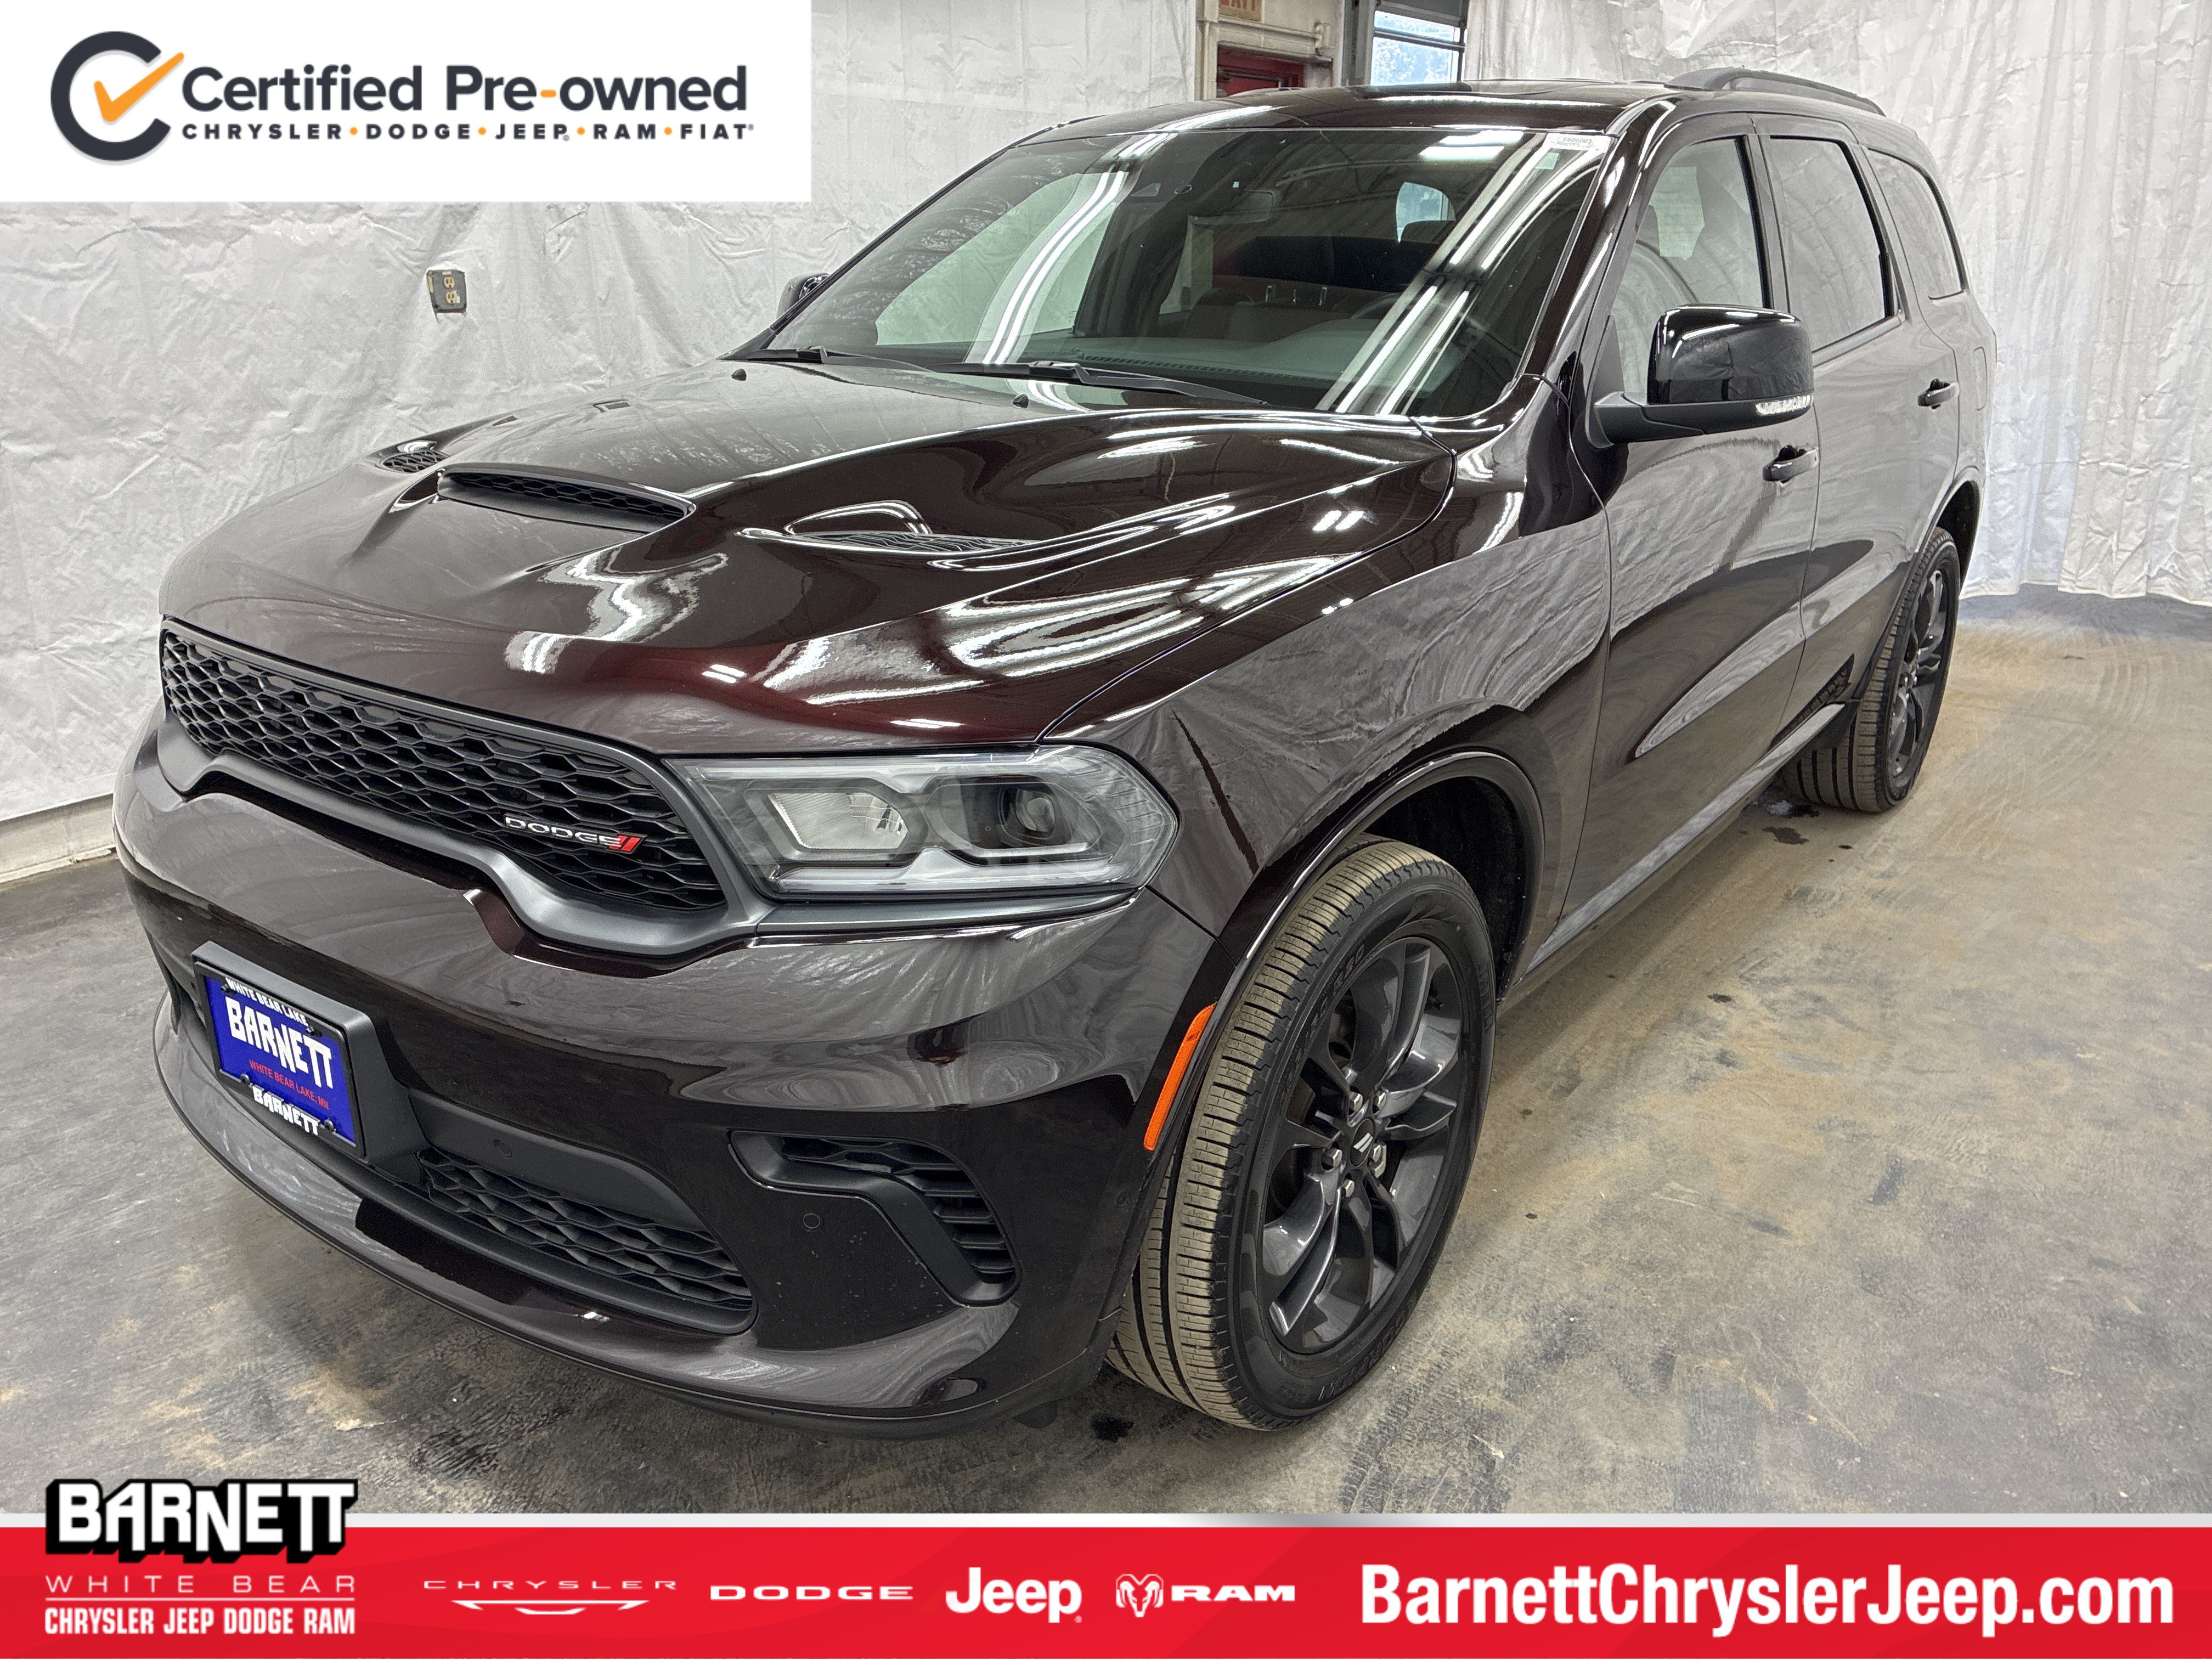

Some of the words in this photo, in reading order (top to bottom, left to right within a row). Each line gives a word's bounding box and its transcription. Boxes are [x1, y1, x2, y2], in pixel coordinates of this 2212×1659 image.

[505, 816, 622, 847] DODGE
[225, 977, 257, 1002] WHITE
[258, 995, 284, 1014] BEAR
[281, 1004, 309, 1027] LAKE
[225, 996, 334, 1090] BARNETT
[248, 1059, 274, 1080] WHITE
[274, 1071, 296, 1091] BEAR
[252, 1084, 321, 1136] BARNETT
